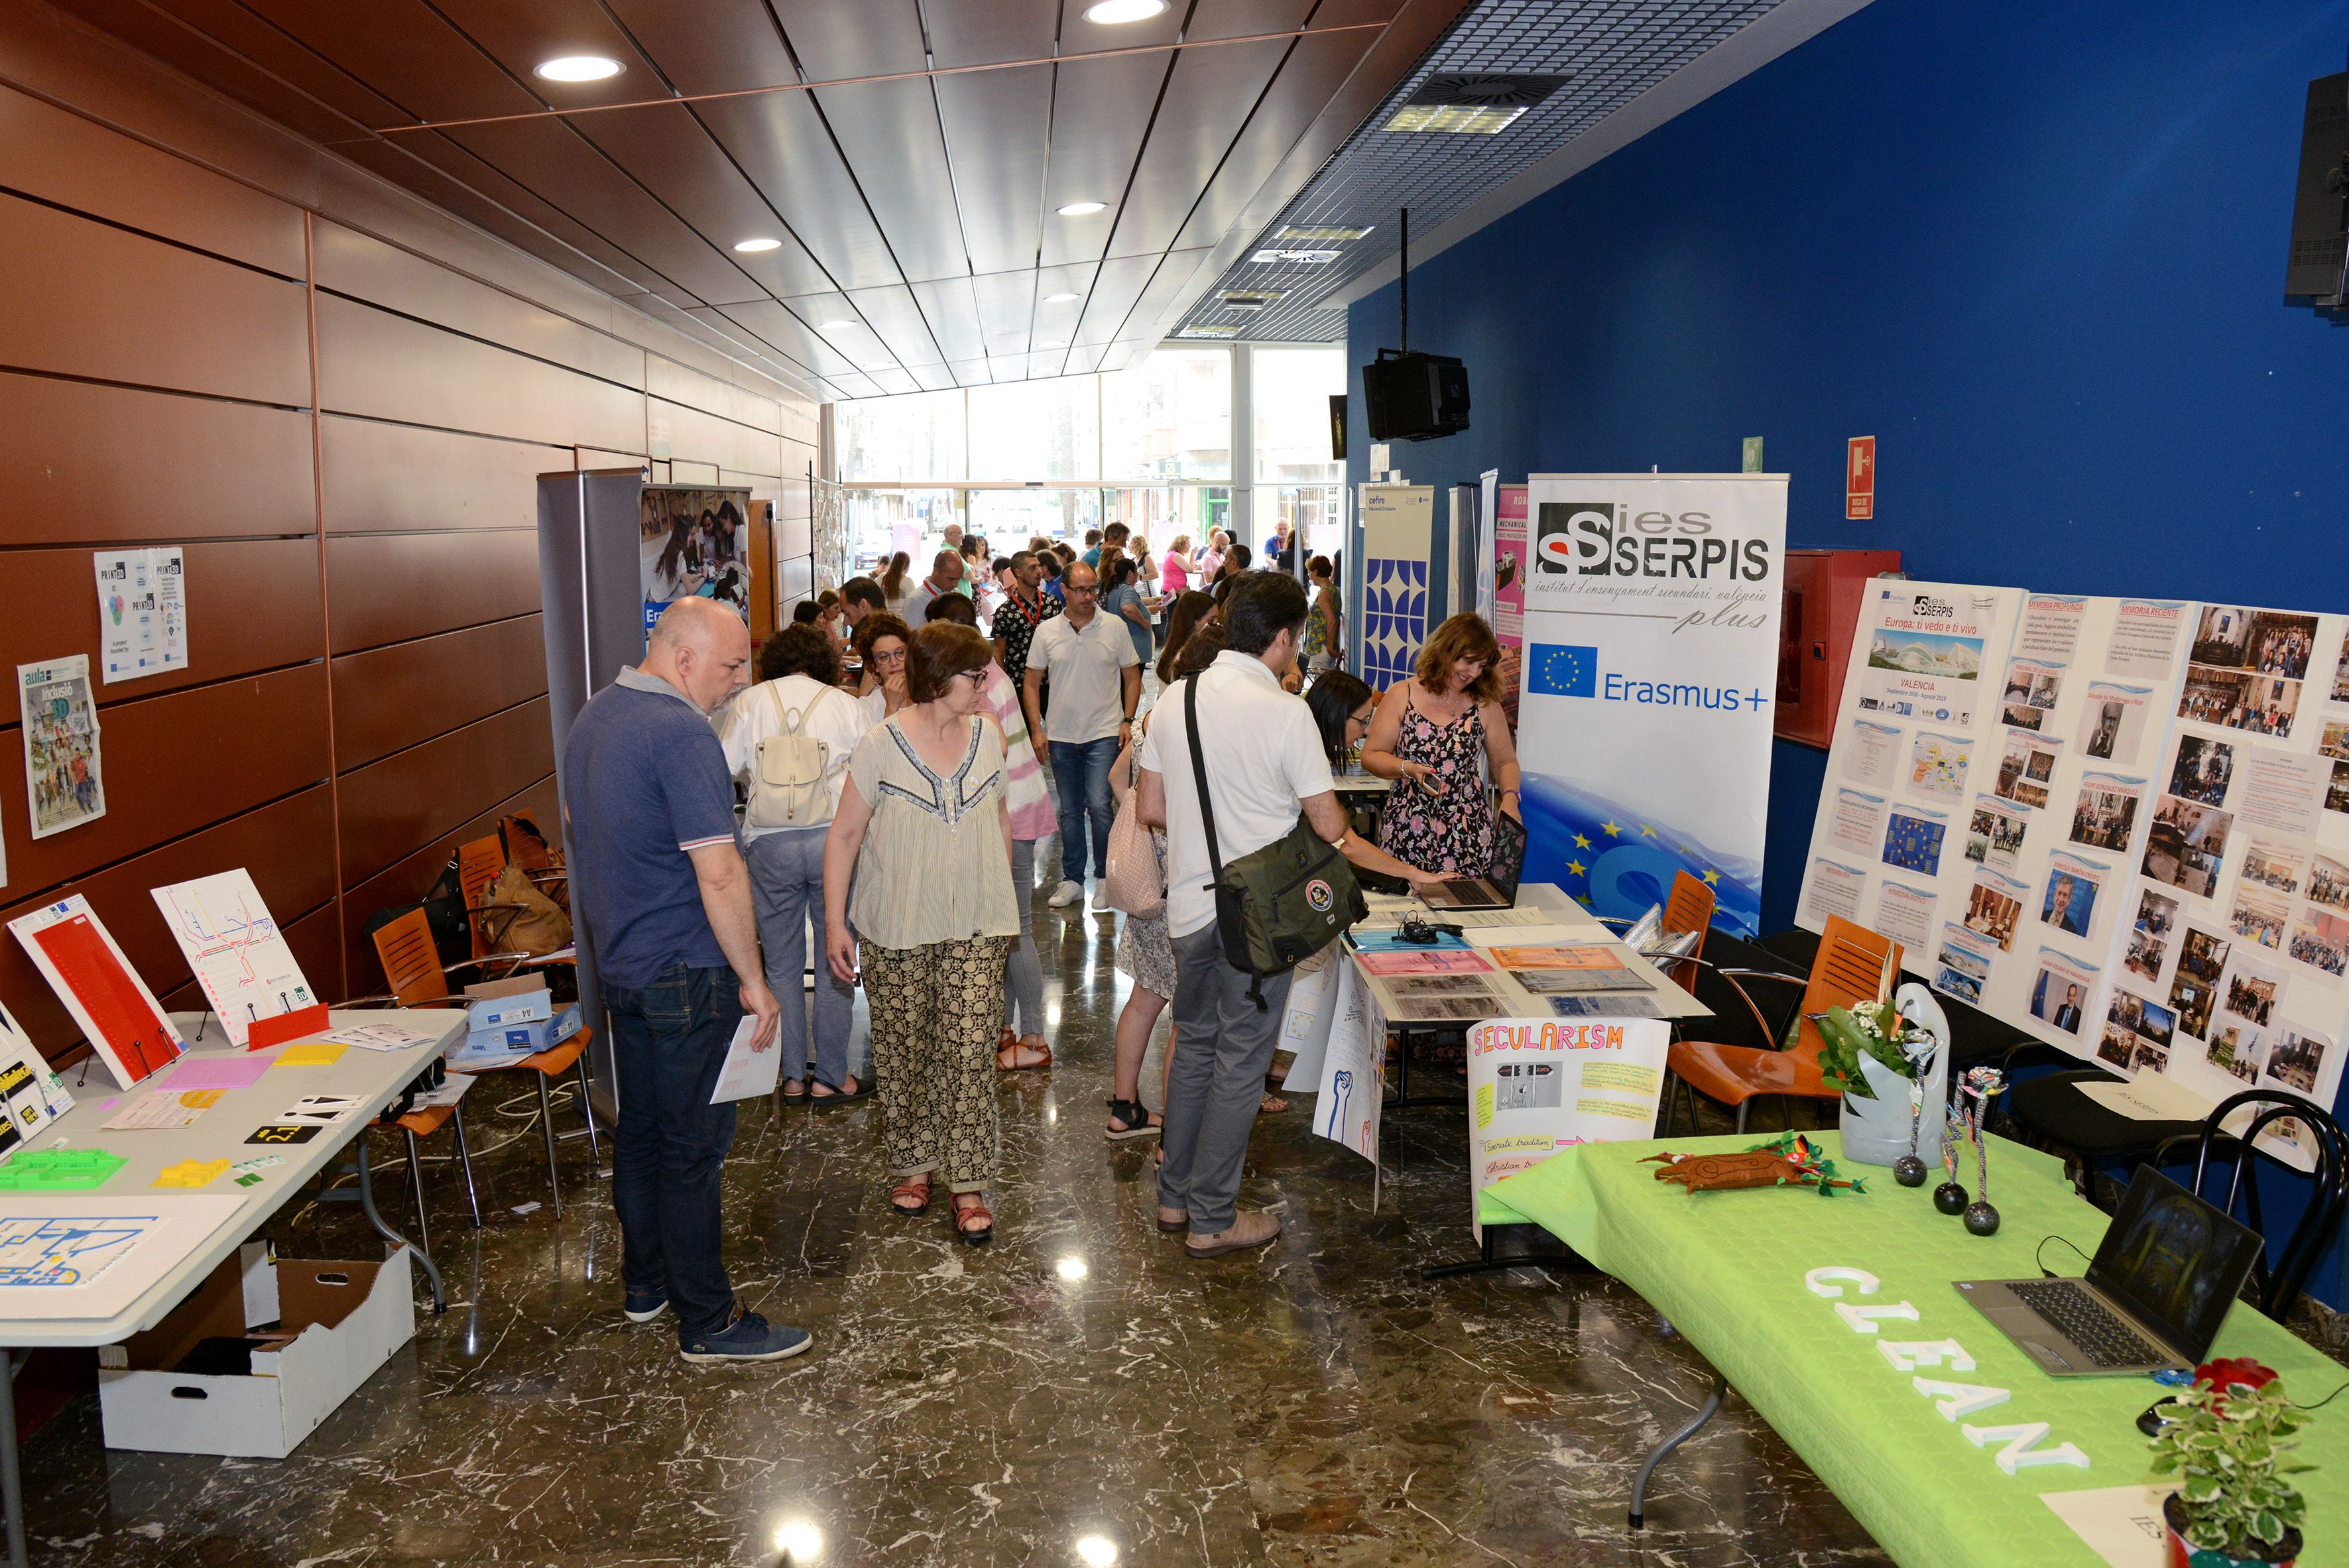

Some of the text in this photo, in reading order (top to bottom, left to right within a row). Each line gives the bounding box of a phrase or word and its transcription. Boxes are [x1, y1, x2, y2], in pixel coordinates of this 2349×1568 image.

[1369, 495, 1385, 504] cefire
[1618, 503, 1713, 535] ies
[1614, 536, 1769, 581] SERPIS
[1534, 580, 1576, 593] institut
[1577, 577, 1657, 602] d'ensenyament
[1714, 585, 1767, 601] valència
[1929, 597, 1945, 605] ies
[1672, 599, 1768, 634] plus
[1927, 605, 1953, 618] SERPIS
[2121, 606, 2179, 617] MEMORIA RECIENTE
[1885, 617, 1915, 629] Europa:
[1917, 620, 1923, 629] ti
[1925, 621, 1943, 631] vedo
[1953, 623, 1958, 633] ti
[1961, 625, 1977, 634] vivo
[25, 668, 46, 686] aula
[1901, 678, 1935, 691] VALENCIA
[42, 682, 74, 701] Inclusió
[50, 698, 70, 719] 3D
[2054, 862, 2071, 872] ENRIQUE
[1475, 1022, 1624, 1056] SECULARISM
[1486, 1138, 1512, 1151] Socratic
[1486, 1161, 1520, 1175] Christian
[1805, 1265, 2090, 1476] CLEAN
